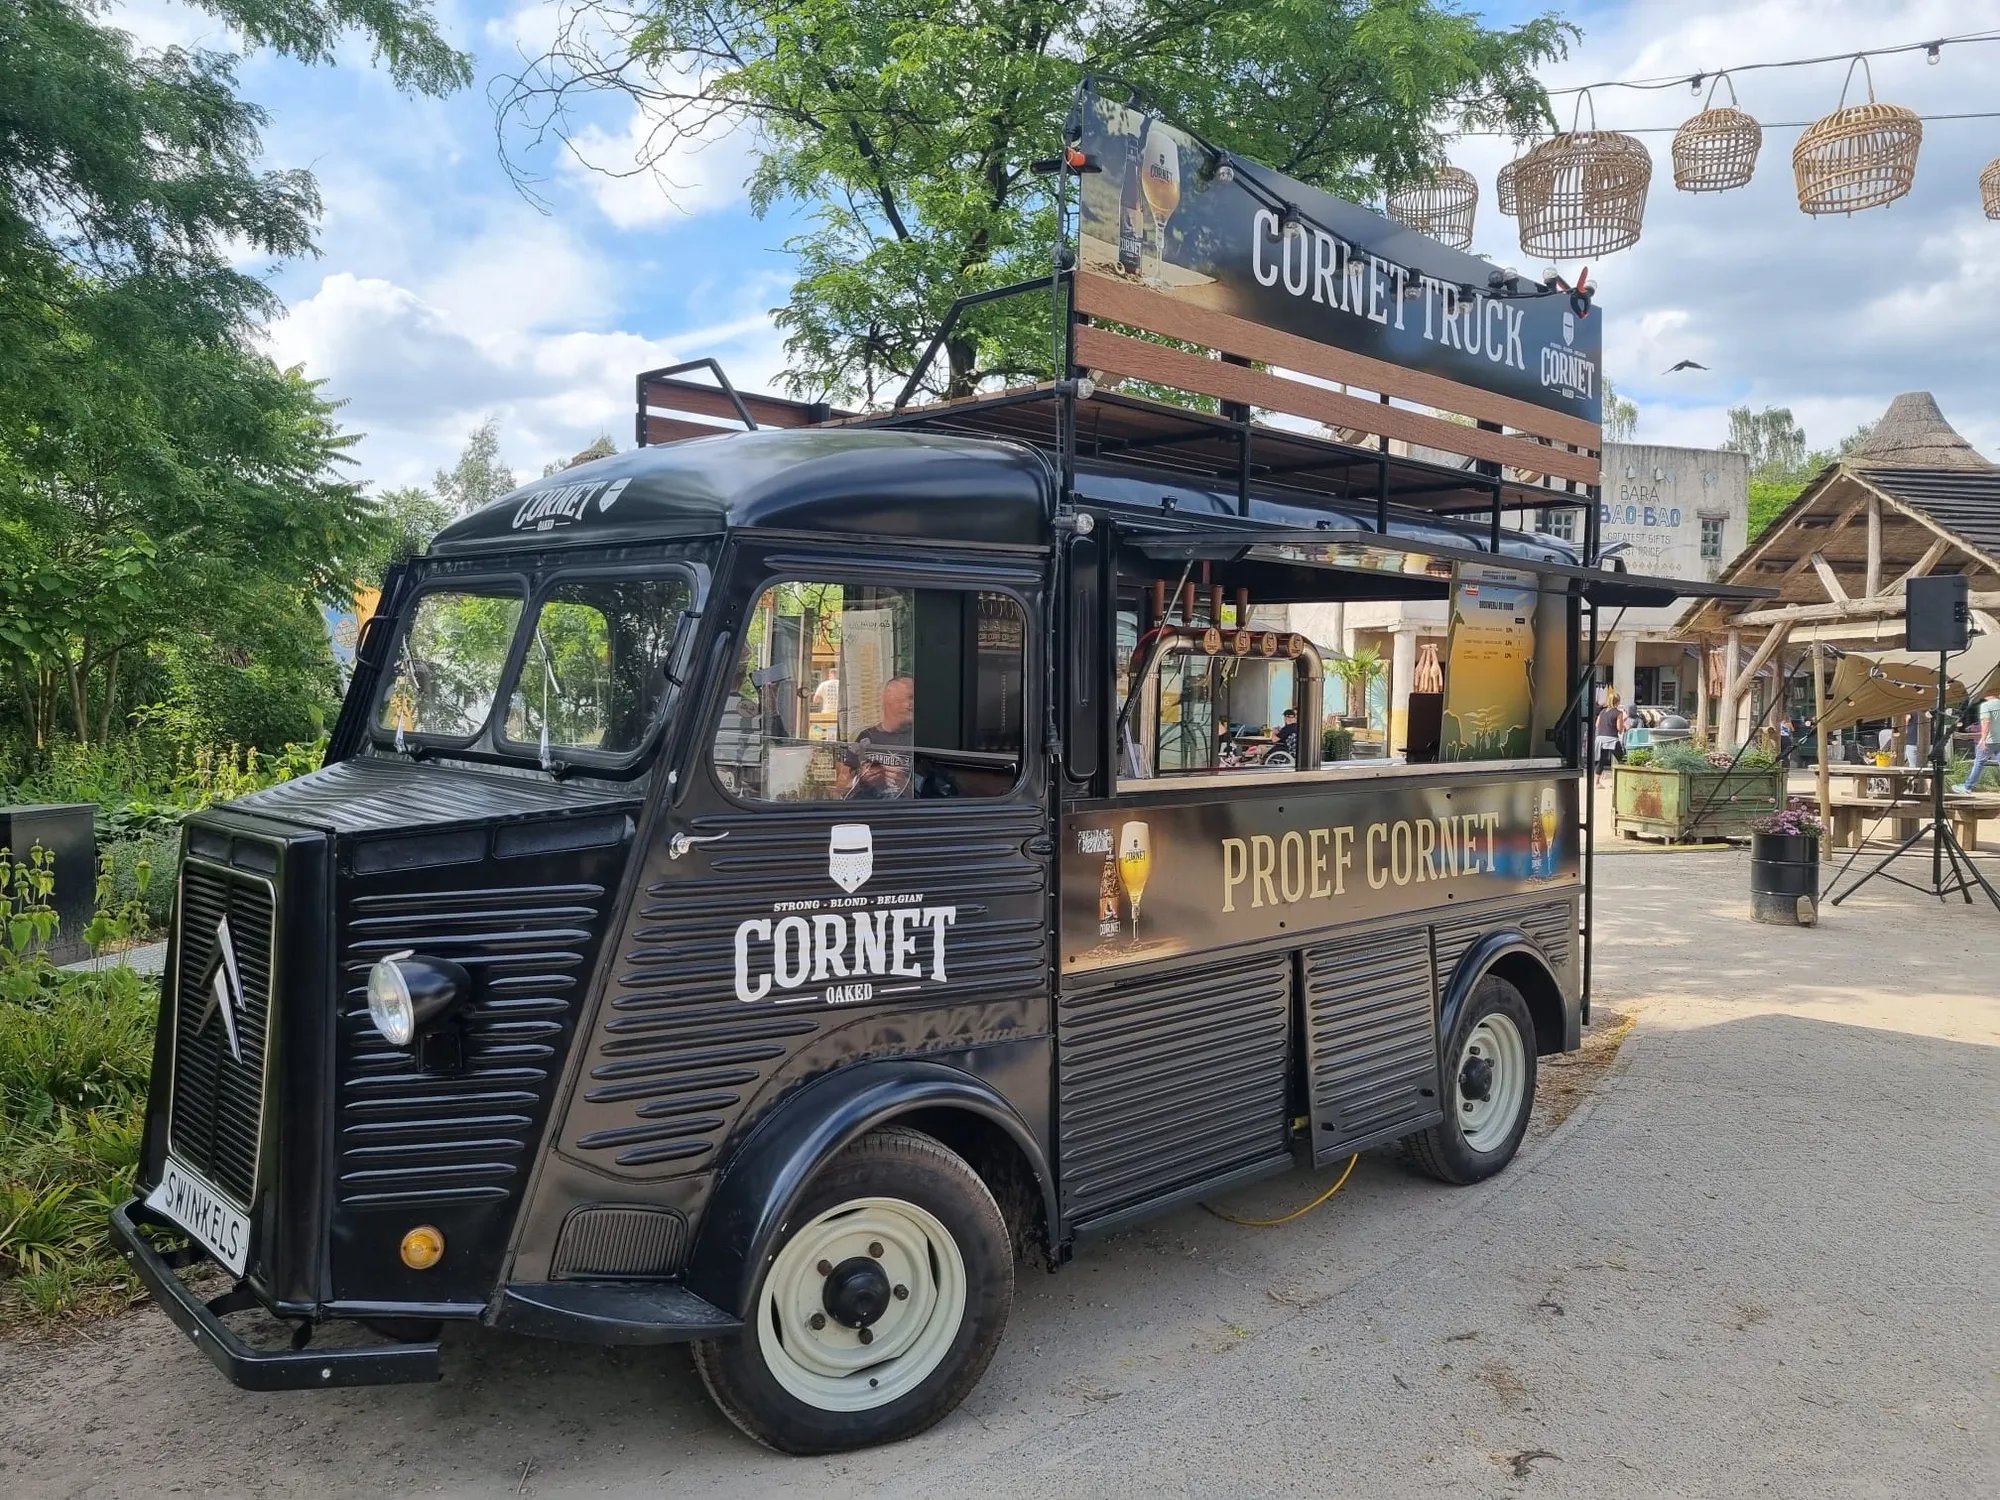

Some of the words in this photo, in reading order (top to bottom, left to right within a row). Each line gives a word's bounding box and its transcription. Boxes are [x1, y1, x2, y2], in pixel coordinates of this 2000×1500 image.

[1253, 208, 1410, 331] CORNET
[1419, 275, 1526, 371] TRUCK
[1541, 346, 1595, 399] CORNET
[511, 480, 609, 529] CORNET
[1600, 504, 1681, 528] BAO-BAO
[1222, 826, 1354, 913] PROEF
[1366, 812, 1499, 890] CORNET
[773, 900, 820, 912] STRONG
[829, 896, 868, 909] BLOND
[877, 893, 924, 905] BELGIAN
[734, 906, 956, 1003] CORNET
[826, 983, 873, 1004] OAKED
[165, 1171, 240, 1261] SWINKELS
